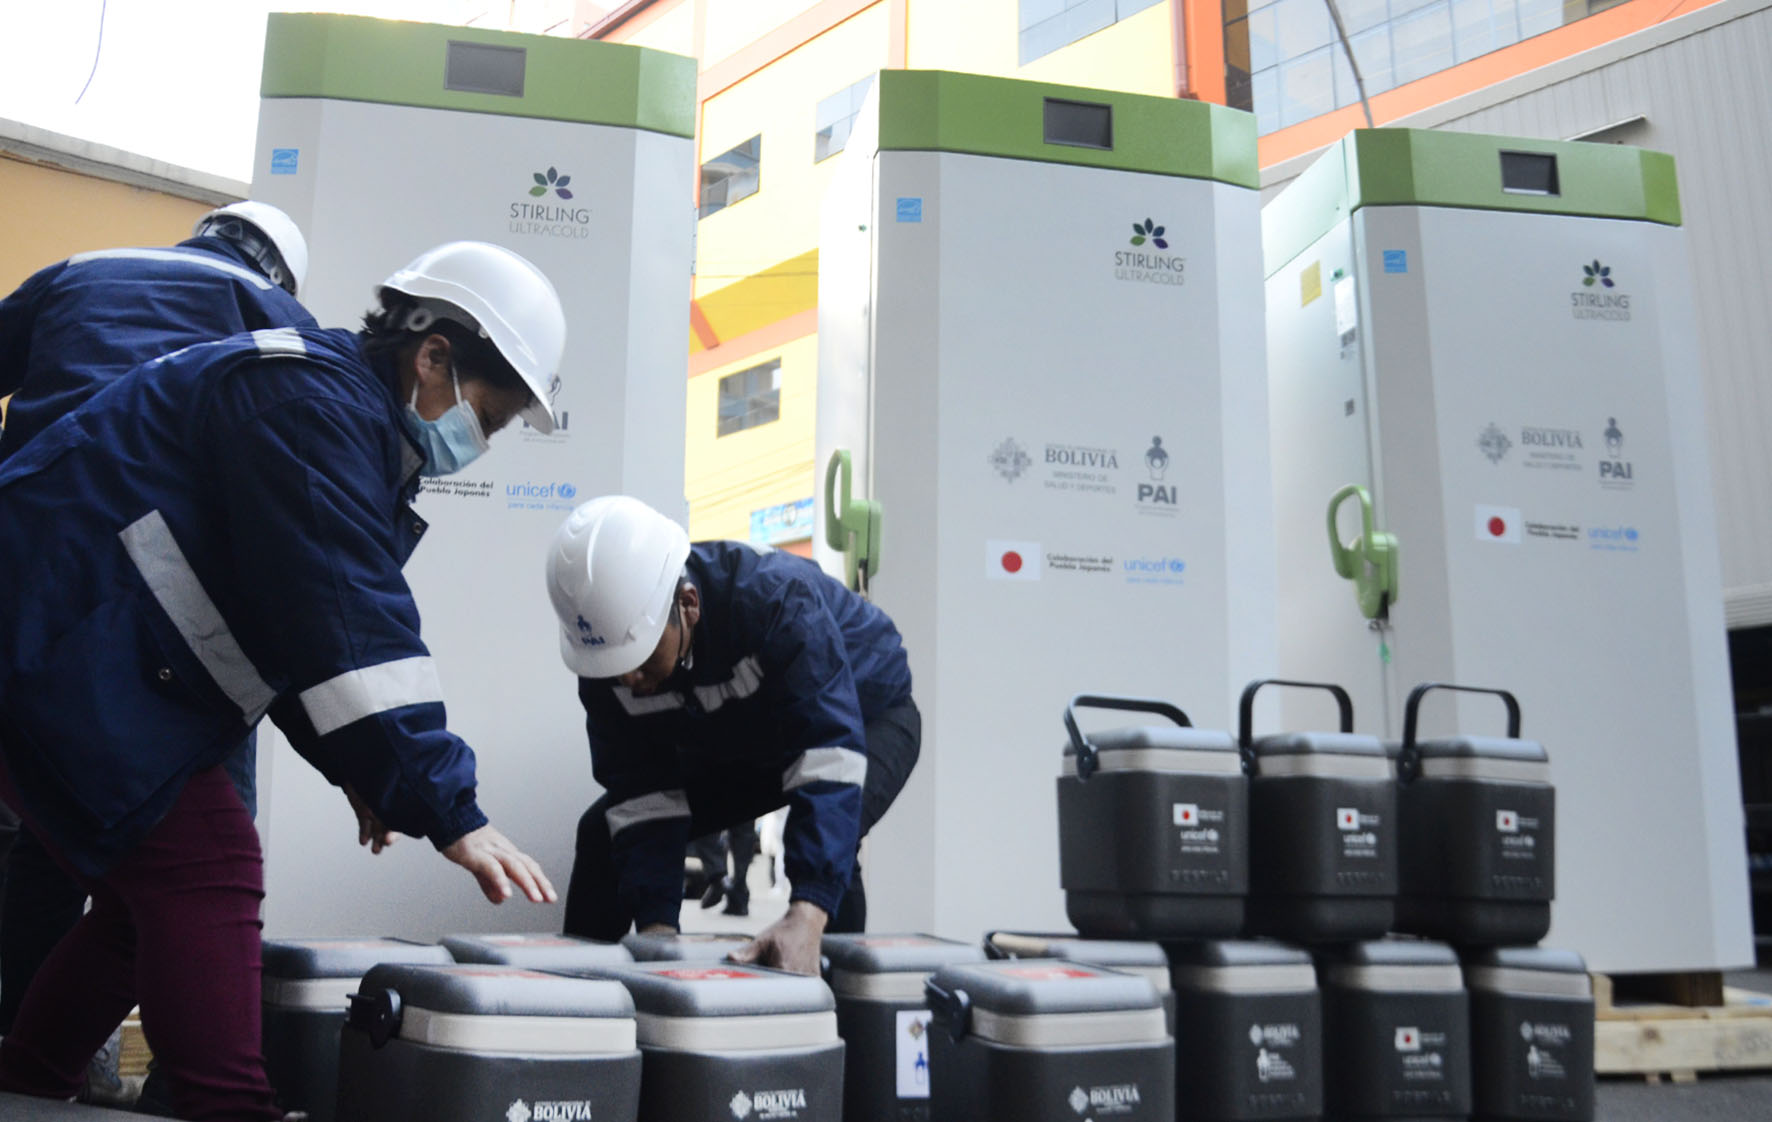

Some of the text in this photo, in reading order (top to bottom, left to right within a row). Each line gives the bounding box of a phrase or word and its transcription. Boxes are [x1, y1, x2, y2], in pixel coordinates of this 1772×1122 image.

[510, 202, 589, 224] STIRLING
[509, 222, 589, 239] ULTRACOLD
[1115, 251, 1184, 272] STIRLING
[1115, 268, 1184, 286] ULTRACOLD
[1571, 292, 1630, 309] STIRLING
[1522, 432, 1582, 449] BOLIVIA
[1045, 448, 1118, 469] BOLIVIA
[1599, 460, 1632, 479] PAI
[480, 481, 494, 489] del
[506, 481, 555, 498] unicef
[1138, 483, 1177, 505] PAI
[1123, 557, 1166, 573] unicef
[754, 1092, 807, 1111] BOLIVIA
[1090, 1087, 1140, 1106] BOLIVIA
[533, 1104, 592, 1121] BOLIVIA
